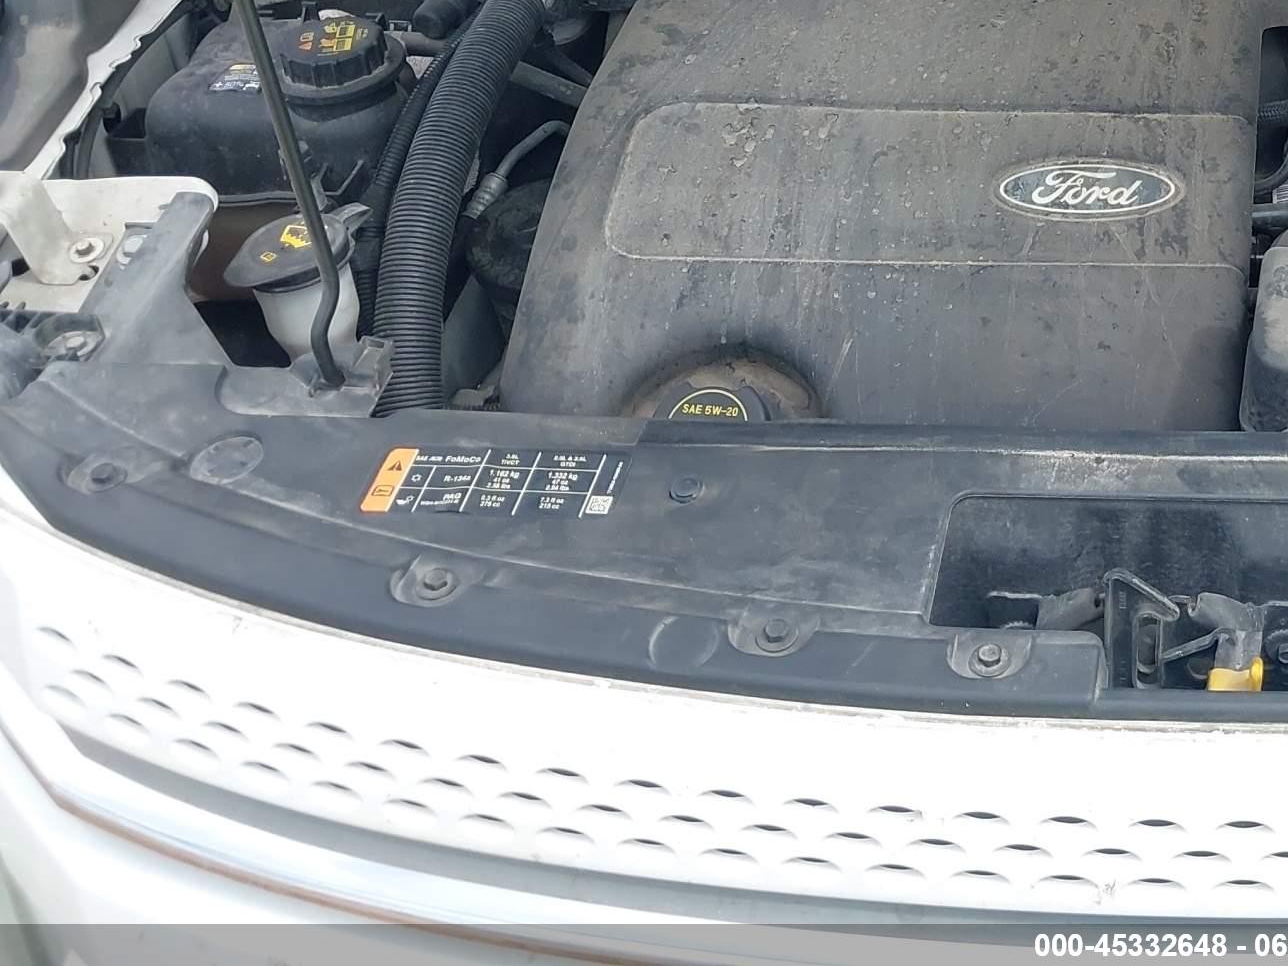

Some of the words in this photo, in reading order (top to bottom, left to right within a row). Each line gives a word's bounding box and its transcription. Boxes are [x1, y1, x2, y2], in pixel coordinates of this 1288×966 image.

[1031, 169, 1143, 206] Ford
[682, 403, 702, 415] SAE
[704, 405, 739, 417] 5W-20
[445, 455, 481, 463] FoMoCo
[444, 474, 472, 483] R-134a
[509, 470, 520, 479] kg
